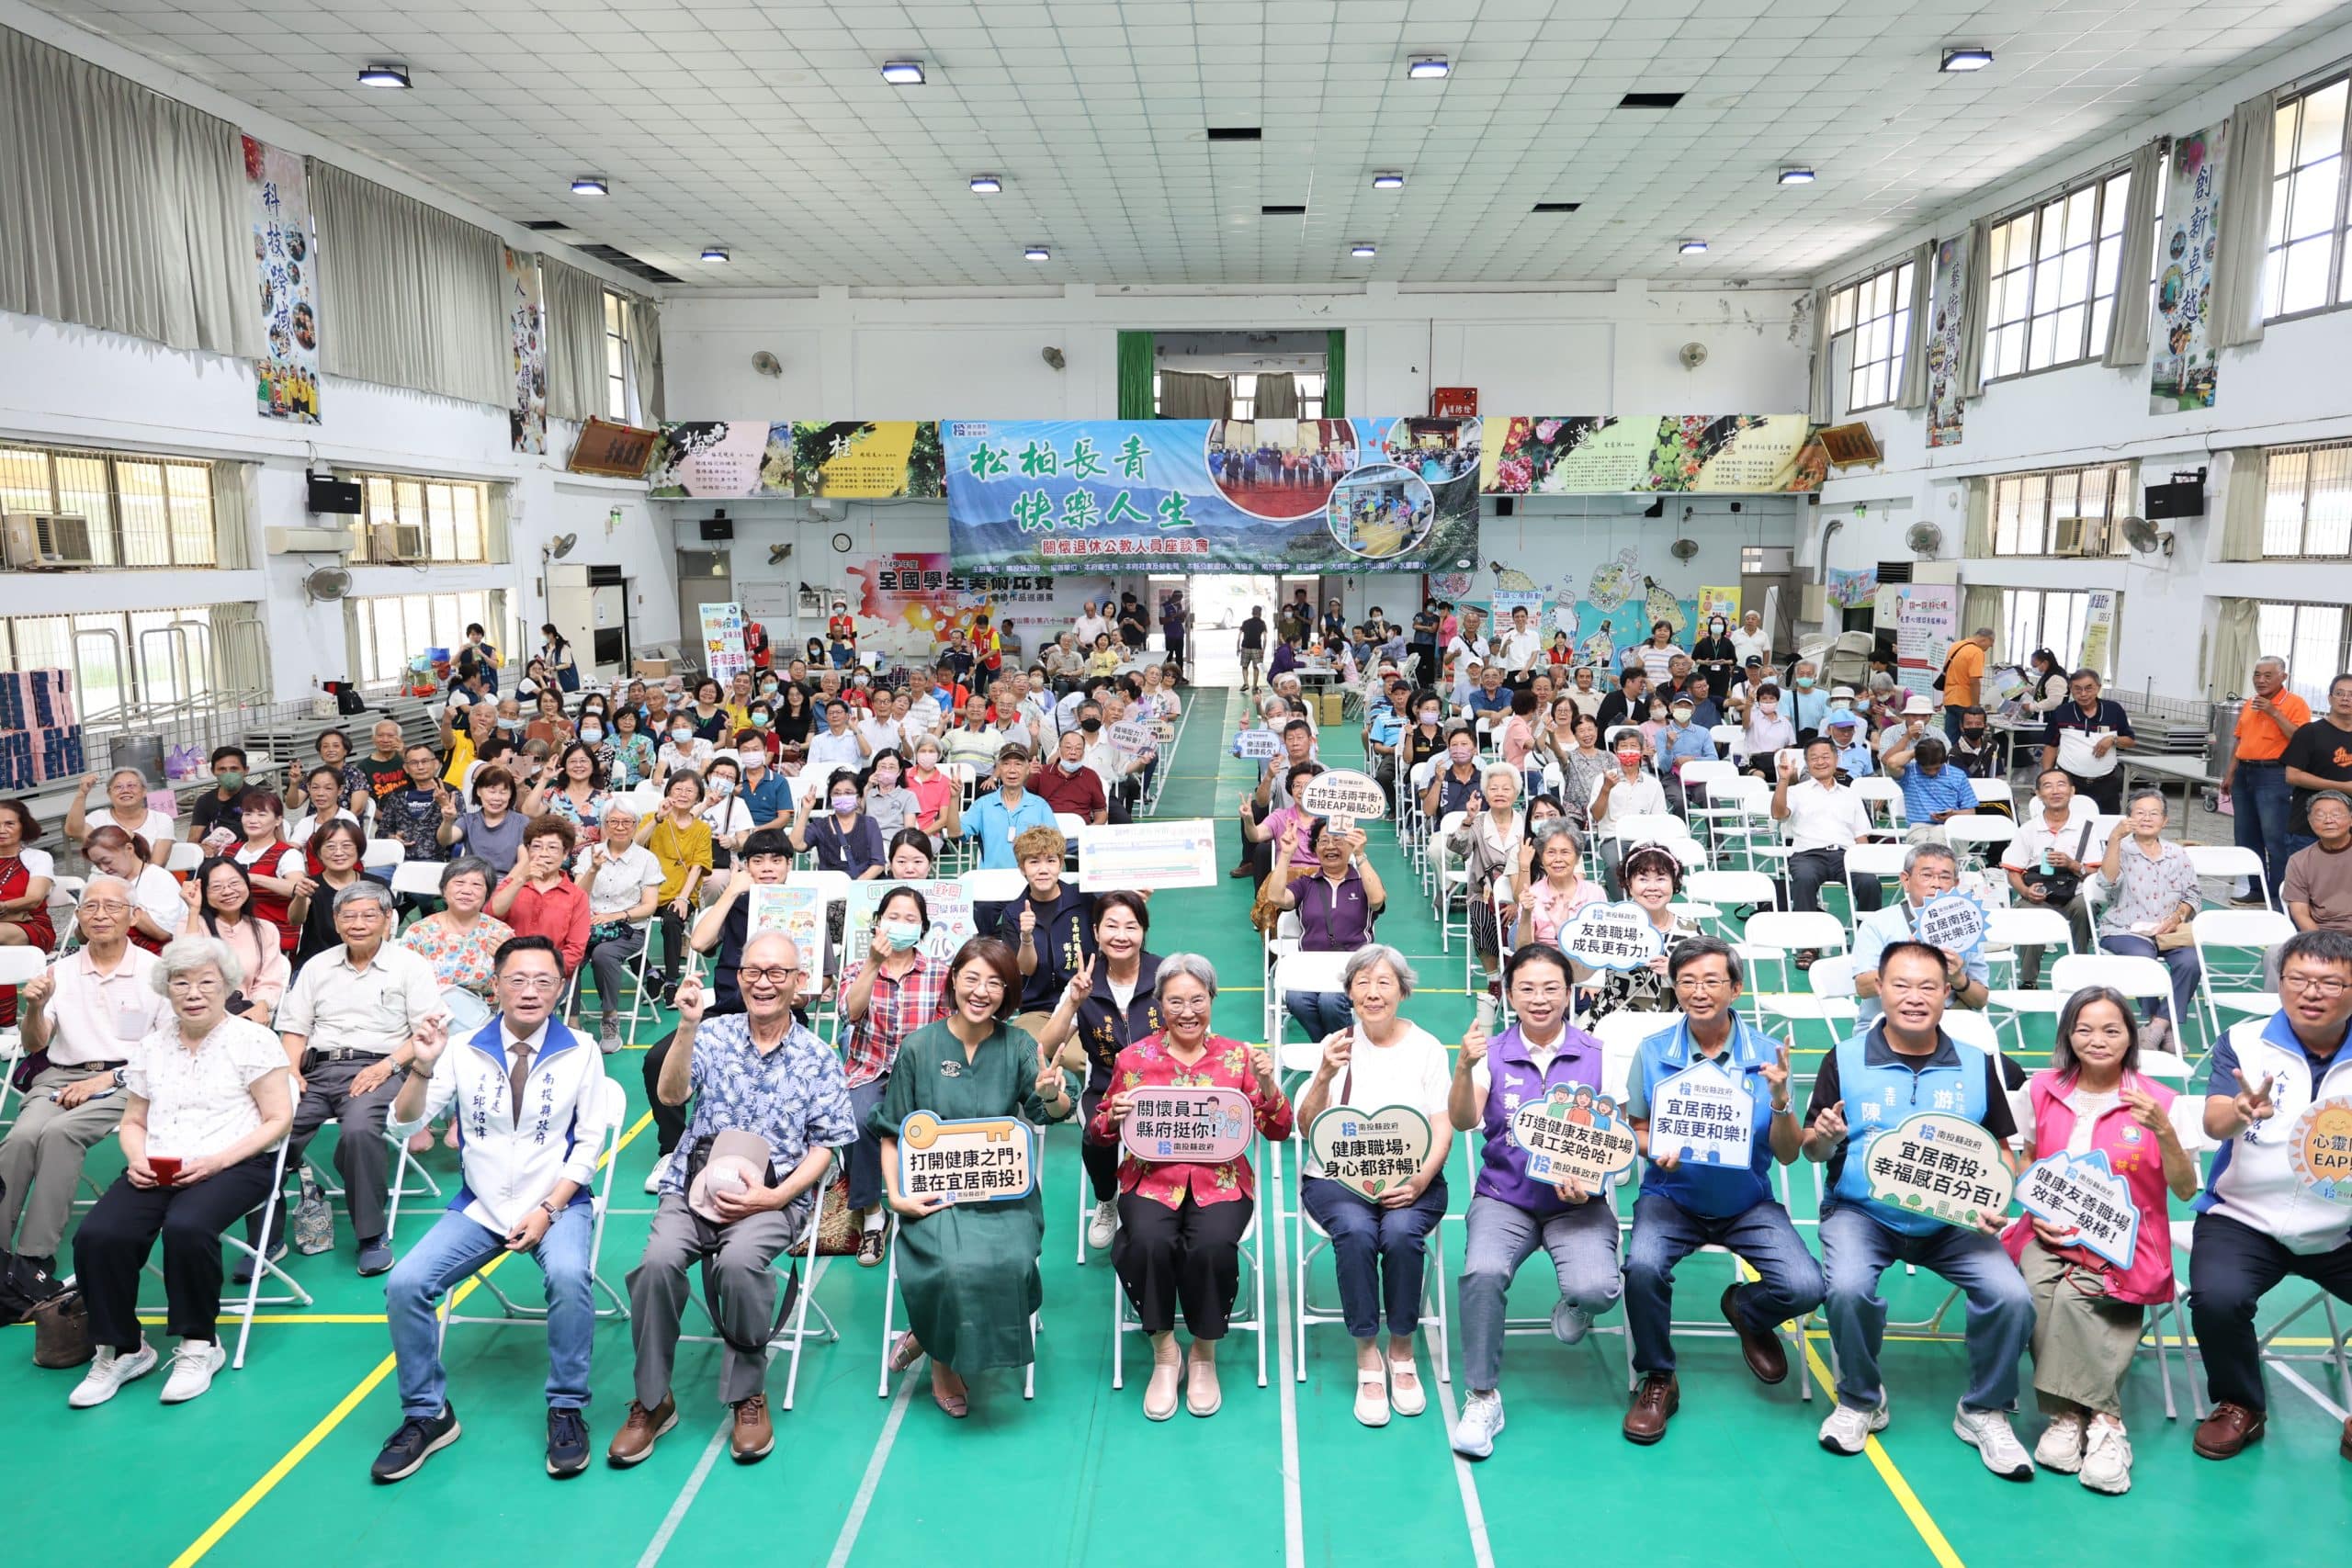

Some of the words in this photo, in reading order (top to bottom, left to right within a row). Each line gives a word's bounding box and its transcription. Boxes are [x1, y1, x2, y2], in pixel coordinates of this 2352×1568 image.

[2179, 164, 2212, 322] 創新卓越
[263, 182, 293, 336] 科技跨域
[681, 432, 707, 457] 梅
[829, 434, 853, 459] 桂
[970, 435, 1150, 481] 松柏長青
[1012, 490, 1194, 534] 快樂人生
[1042, 538, 1209, 556] 關懷退休公教人員座談會
[1306, 798, 1381, 814] 南投EAP最貼心！
[1307, 787, 1382, 802] 工作生活兩平衡，
[1440, 782, 1449, 807] FILA
[1581, 922, 1644, 942] 友善職場，
[1924, 910, 1976, 935] 宜居南投，
[1929, 921, 1981, 944] 陽光樂活！
[1572, 938, 1649, 958] 成長更有力！
[1693, 1084, 1734, 1096] 南投縣政府
[1933, 1089, 1954, 1110] 游
[534, 1072, 555, 1145] 南投縣政府
[1137, 1100, 1210, 1118] 關懷員工
[1667, 1099, 1741, 1122] 宜居南投，
[1136, 1121, 1216, 1139] 縣府挺你！
[1359, 1122, 1398, 1131] 南投縣政府
[1519, 1111, 1633, 1155] 打造健康友善職場
[1657, 1117, 1747, 1143] 家庭更和樂！
[1173, 1143, 1214, 1151] 南投縣政府
[1331, 1139, 1411, 1158] 健康職場，
[1530, 1132, 1613, 1166] 員工笑哈哈！
[1937, 1130, 1983, 1150] 南投縣政府
[2312, 1133, 2352, 1153] 心靈
[910, 1147, 1022, 1172] 打開健康之門，
[1324, 1158, 1421, 1178] 身心都舒暢！
[1553, 1161, 1600, 1181] 南投縣政府
[1898, 1141, 1987, 1180] 宜居南投，
[2313, 1153, 2352, 1171] EAP
[910, 1169, 1023, 1192] 盡在宜居南投！
[1873, 1156, 2001, 1208] 幸福感百分百！
[2079, 1174, 2115, 1198] 南投縣政府
[2035, 1167, 2131, 1231] 健康友善職場
[2030, 1184, 2117, 1244] 效率一級棒！
